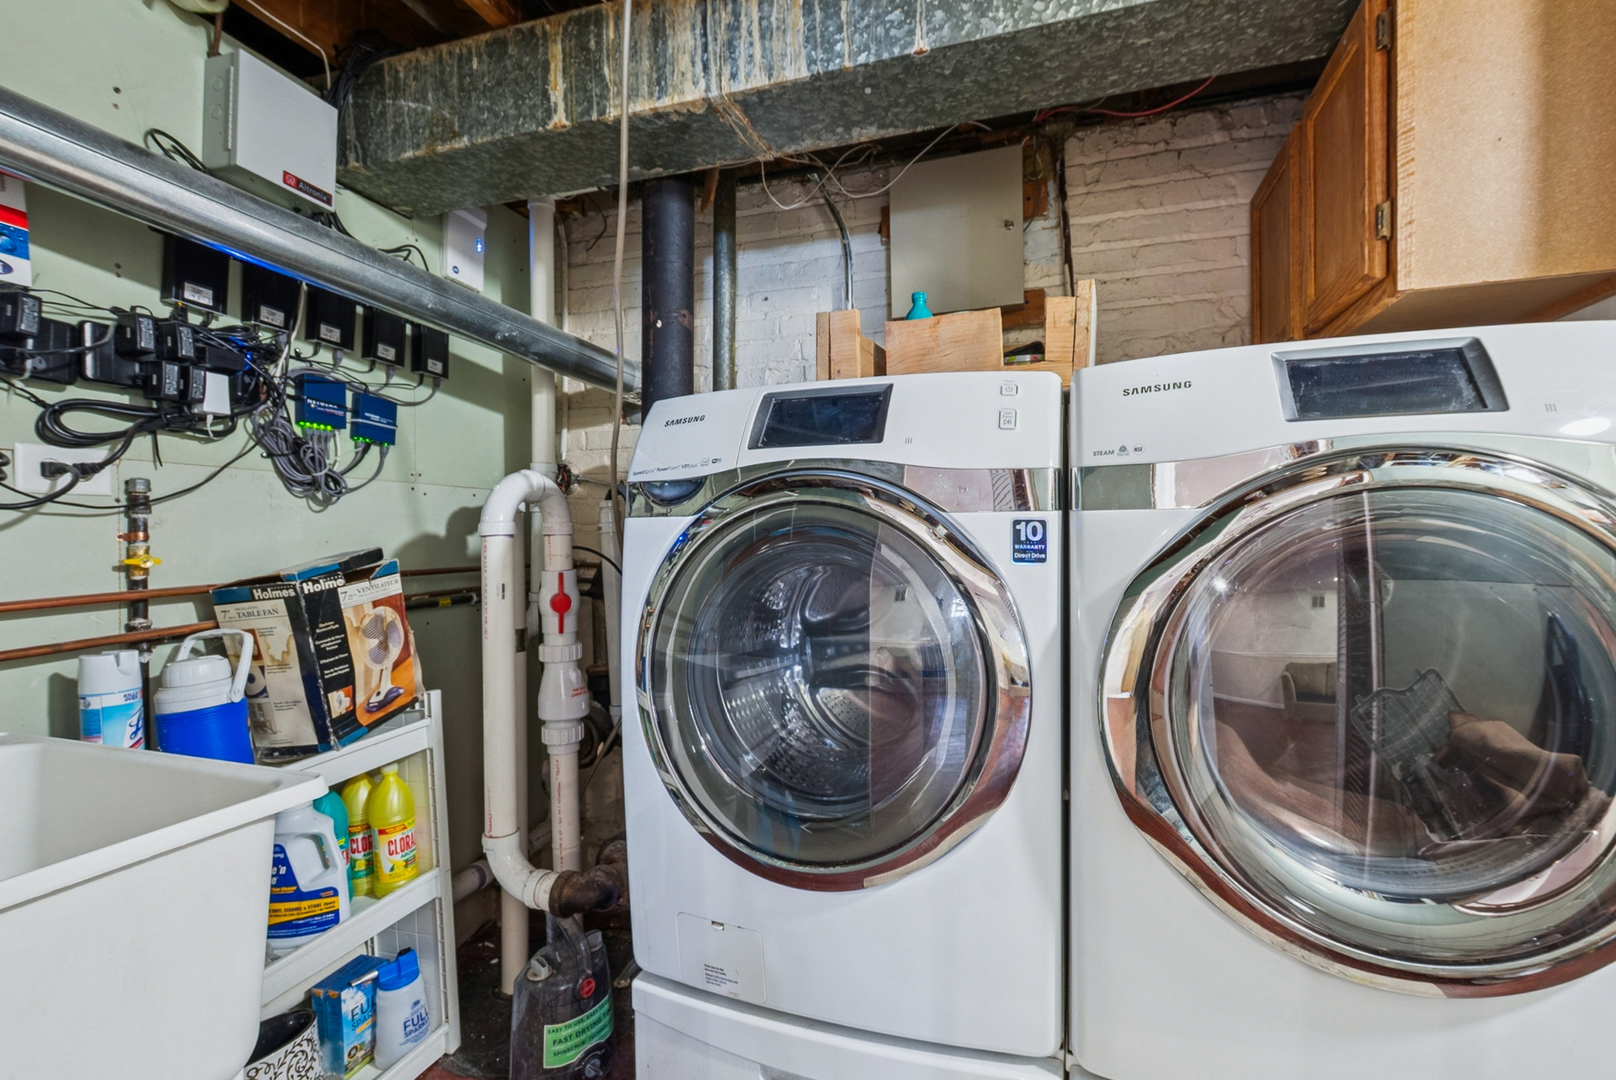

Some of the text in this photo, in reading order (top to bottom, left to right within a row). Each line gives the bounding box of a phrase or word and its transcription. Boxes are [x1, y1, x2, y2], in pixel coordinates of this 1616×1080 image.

[298, 181, 328, 201] Altronix
[1122, 380, 1192, 396] SAMSUNG
[664, 414, 706, 428] SAMSUNG
[1016, 521, 1044, 542] 10
[252, 586, 297, 600] Holmes
[302, 578, 346, 594] Holme
[356, 578, 400, 594] VENTILATEUR
[236, 610, 262, 618] TABLE
[263, 608, 279, 616] FAN
[388, 832, 417, 856] CLORA
[403, 1007, 430, 1032] FULL
[552, 1018, 602, 1046] FAST DRYING
